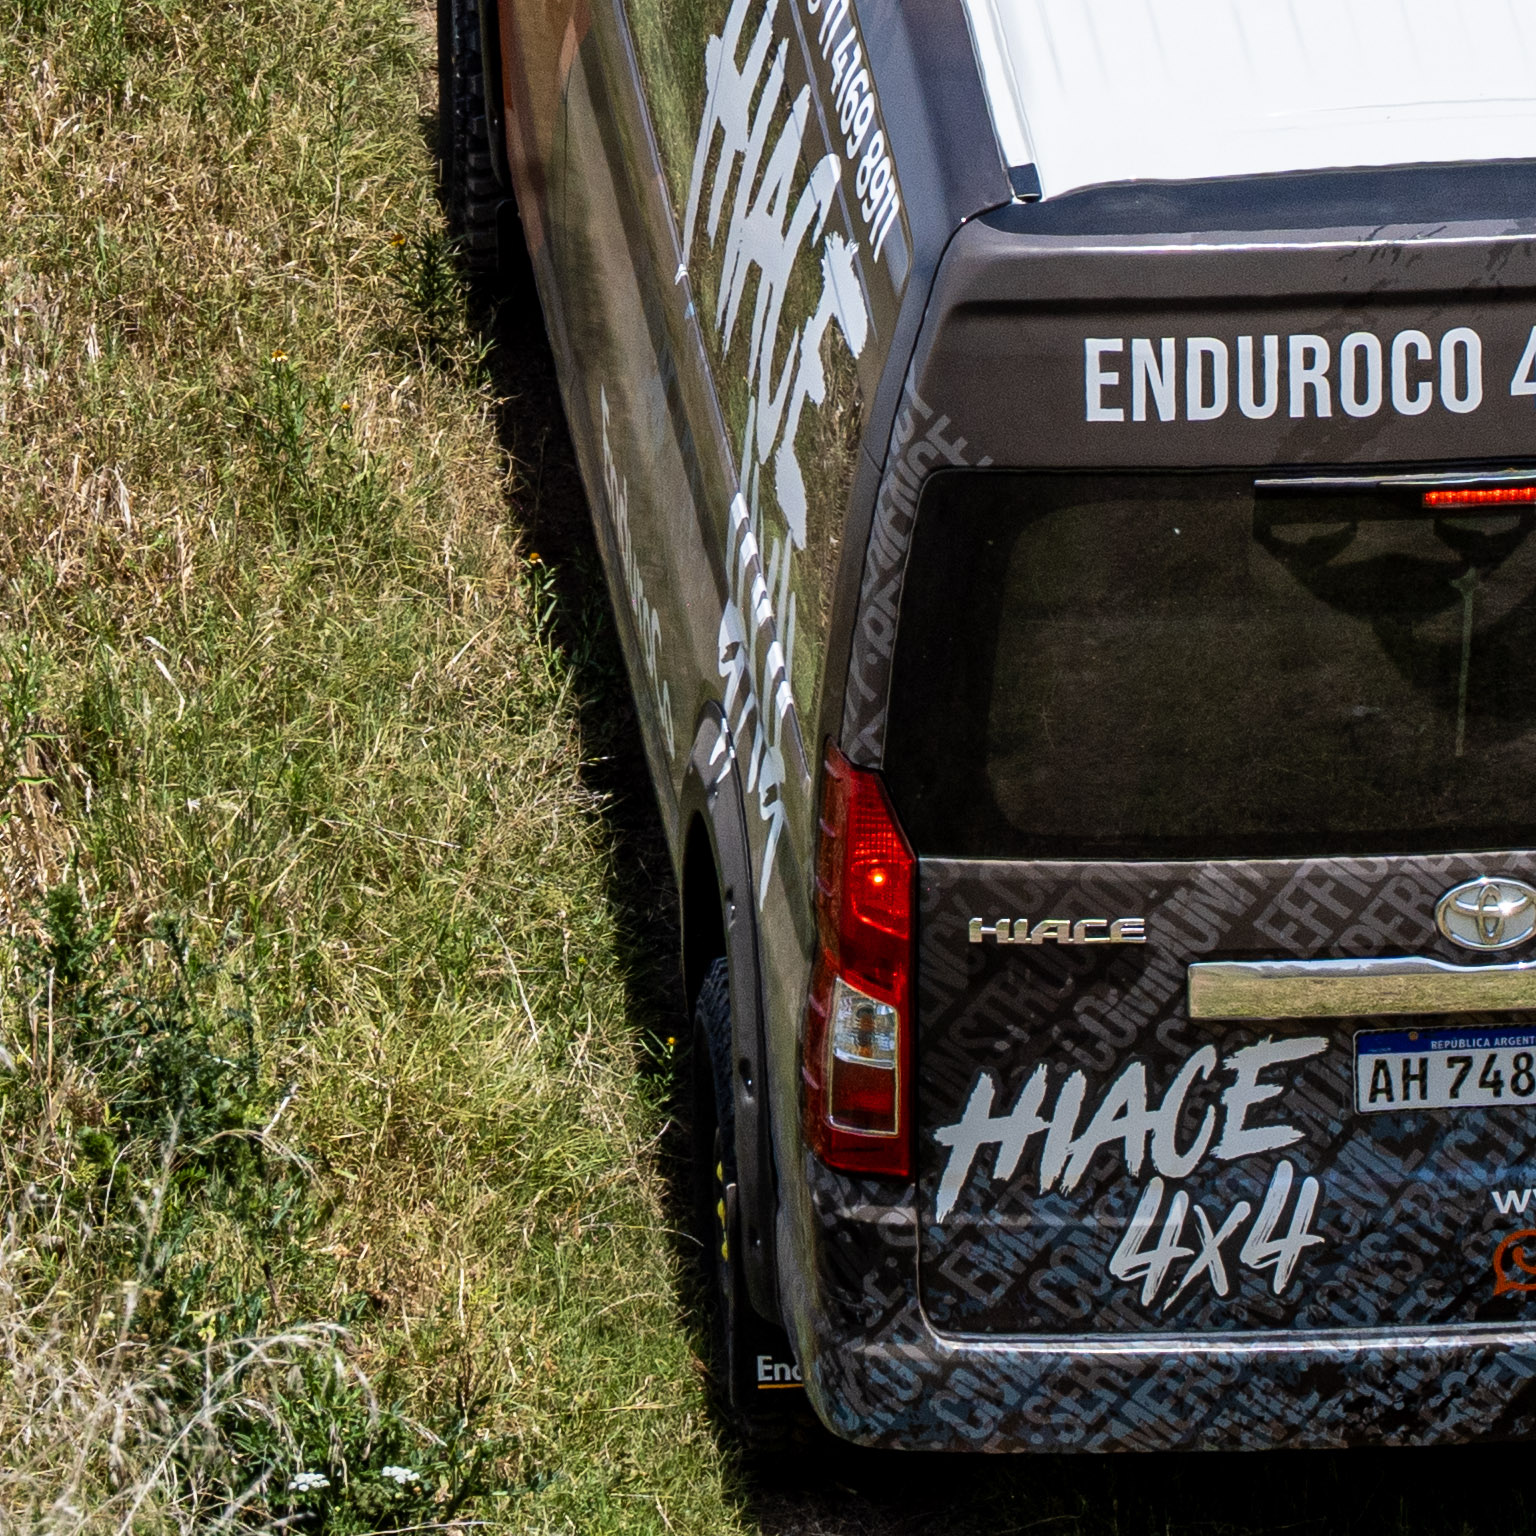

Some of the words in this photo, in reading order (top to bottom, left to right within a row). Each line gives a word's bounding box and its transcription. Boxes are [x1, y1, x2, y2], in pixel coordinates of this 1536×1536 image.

[831, 26, 876, 160] 4169
[855, 130, 901, 263] 8911
[1084, 326, 1484, 423] ENDUROCO
[968, 916, 1147, 945] HIACE
[1368, 1056, 1429, 1104] AH
[1446, 1051, 1536, 1100] 748
[1430, 1037, 1491, 1051] REPÚBLICA
[934, 1035, 1330, 1224] HIACE
